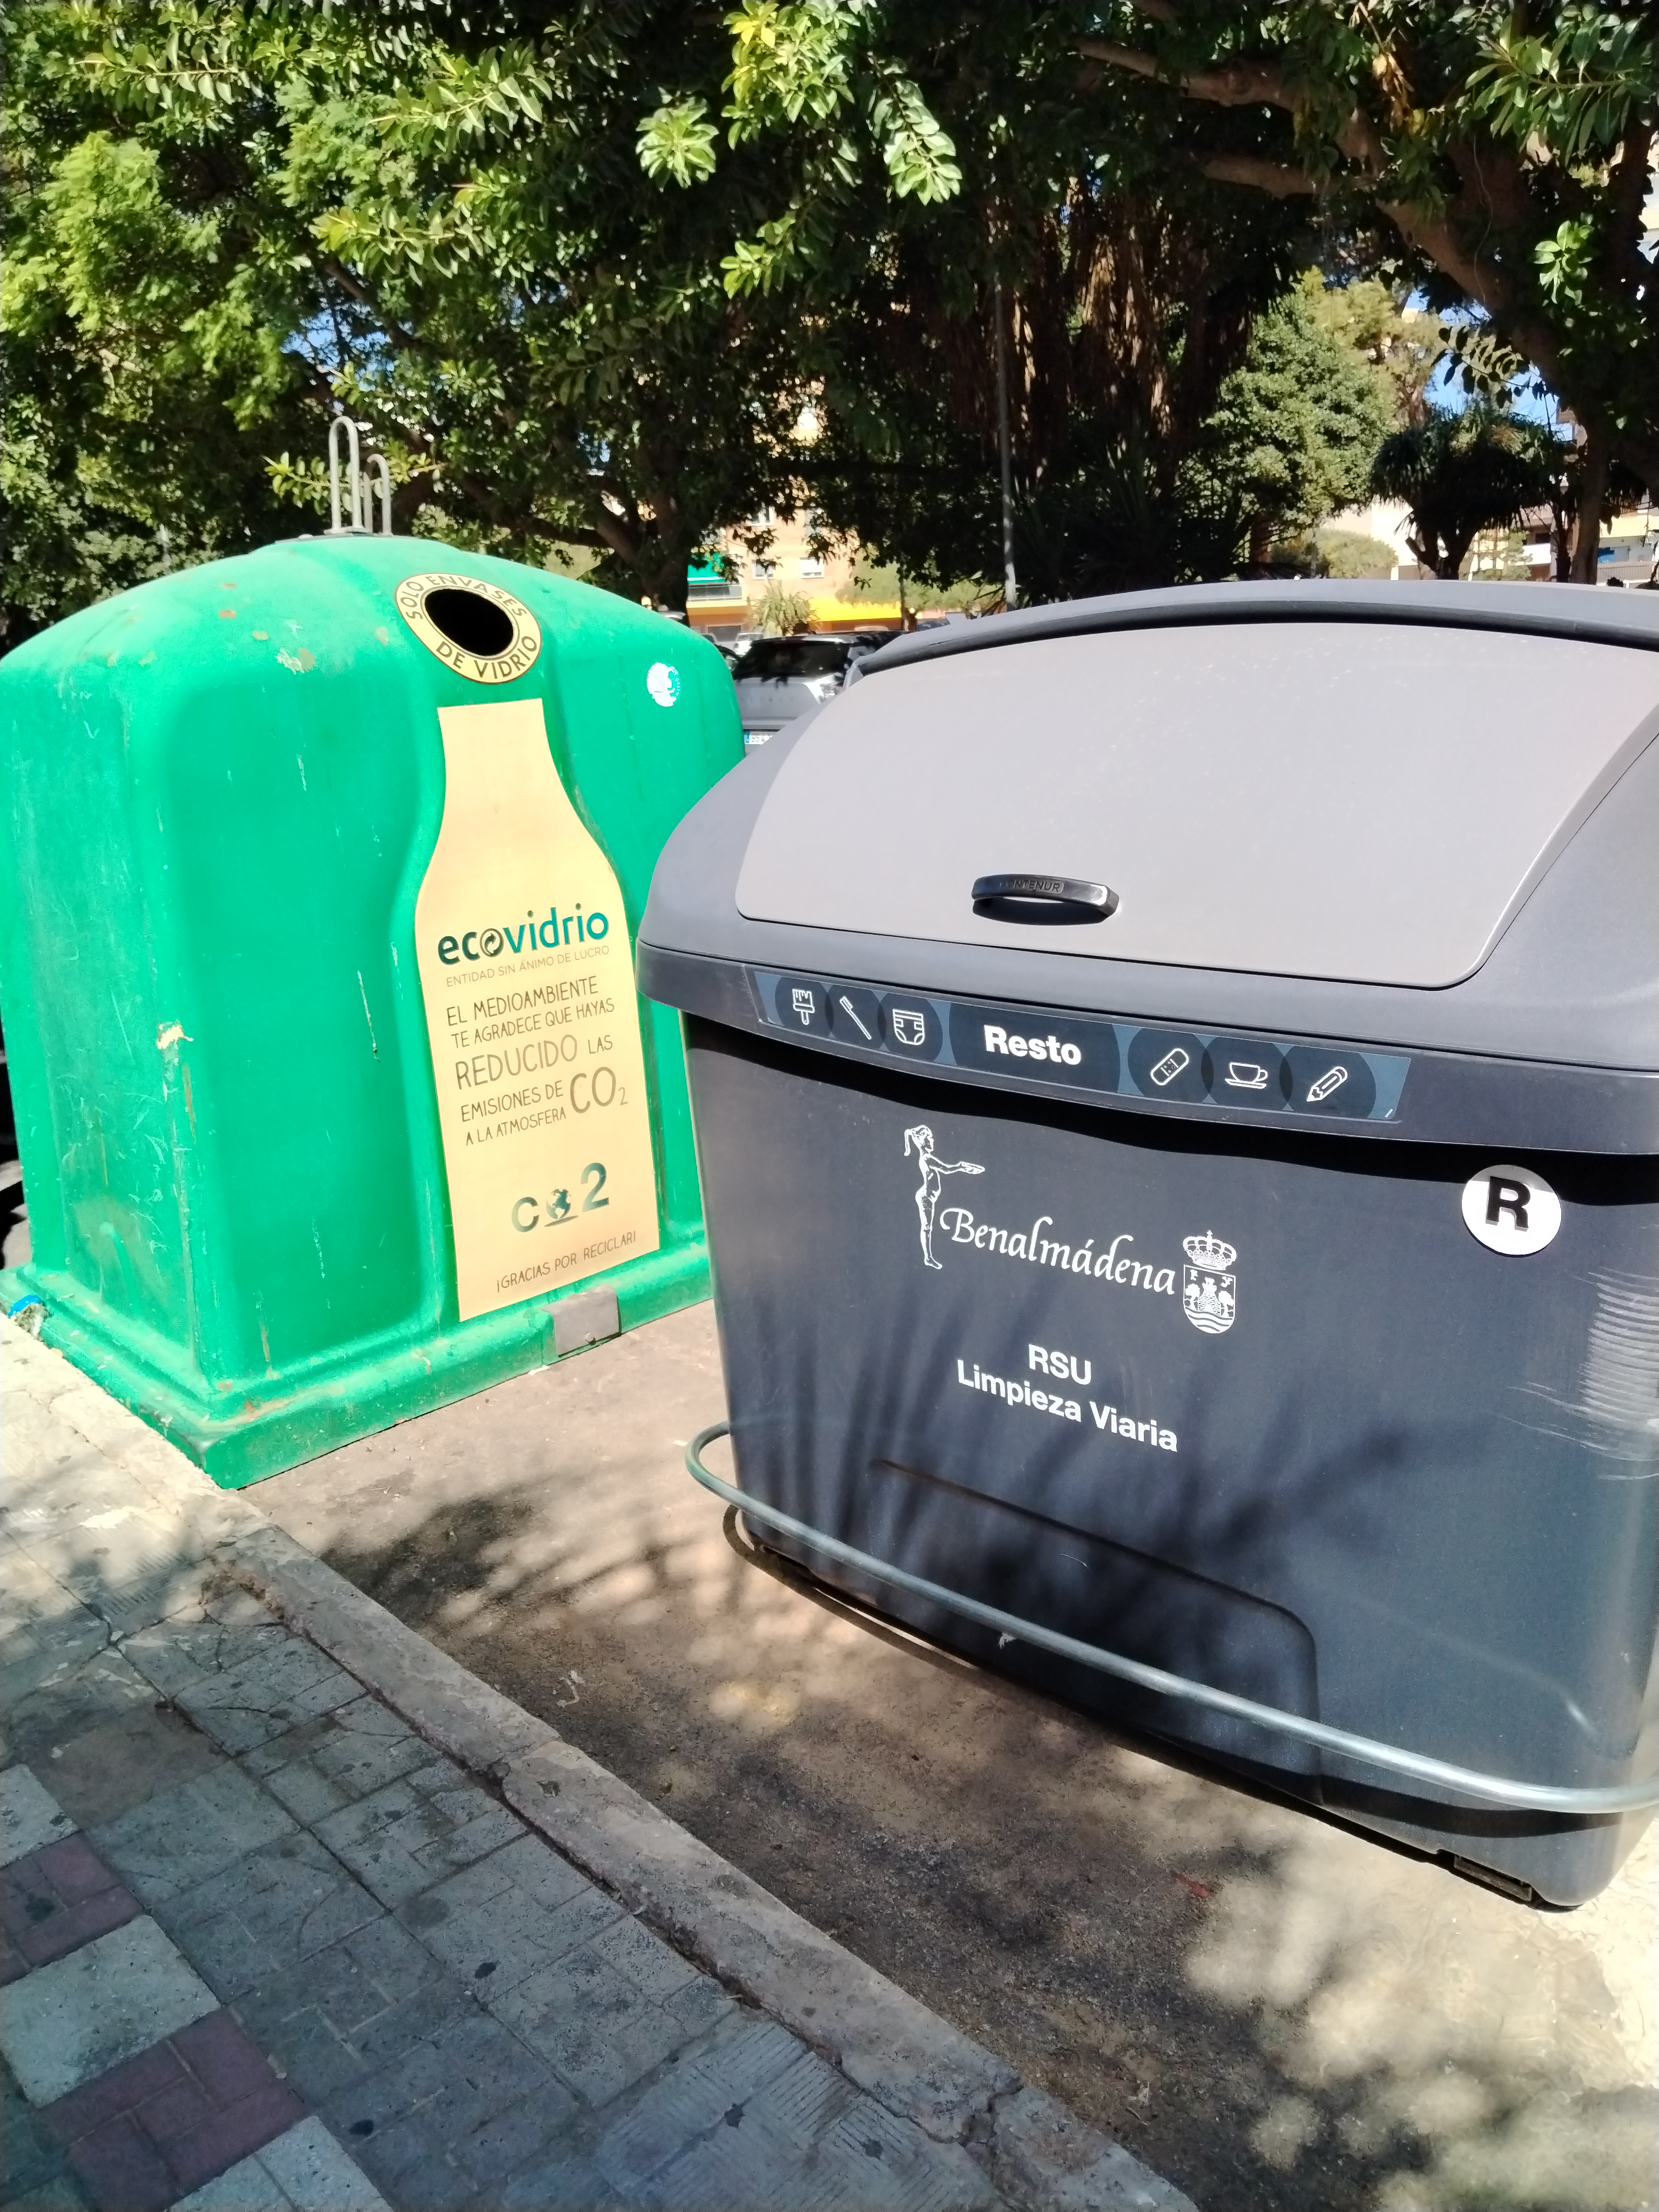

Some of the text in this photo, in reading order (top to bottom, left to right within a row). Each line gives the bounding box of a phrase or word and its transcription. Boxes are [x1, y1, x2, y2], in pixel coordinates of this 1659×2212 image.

[401, 576, 527, 619] SOLO ENVASES
[436, 636, 537, 679] DE VIDRIO
[437, 902, 609, 965] ecovidrio
[447, 968, 494, 987] ENTIDAD
[498, 964, 515, 977] SIN
[557, 953, 571, 964] DE
[574, 946, 609, 961] LUCRO
[447, 976, 598, 1026] EL MEDIOAMBIENTE
[451, 998, 615, 1048] TE AGRADECE QUE HAYAS
[983, 1024, 1082, 1065] Resto
[455, 1034, 613, 1090] REDUCIDO LAS
[461, 1087, 541, 1122] EMISIONES
[545, 1080, 563, 1100] DE
[466, 1107, 567, 1146] A LA ATMOSFERA
[1486, 1176, 1530, 1231] R
[497, 1262, 550, 1292] ¡GRACIAS
[555, 1253, 577, 1271] POR
[940, 1208, 1175, 1295] Benalmádena
[1028, 1344, 1091, 1385] RSU
[957, 1359, 1178, 1452] Limpieza Viaria
